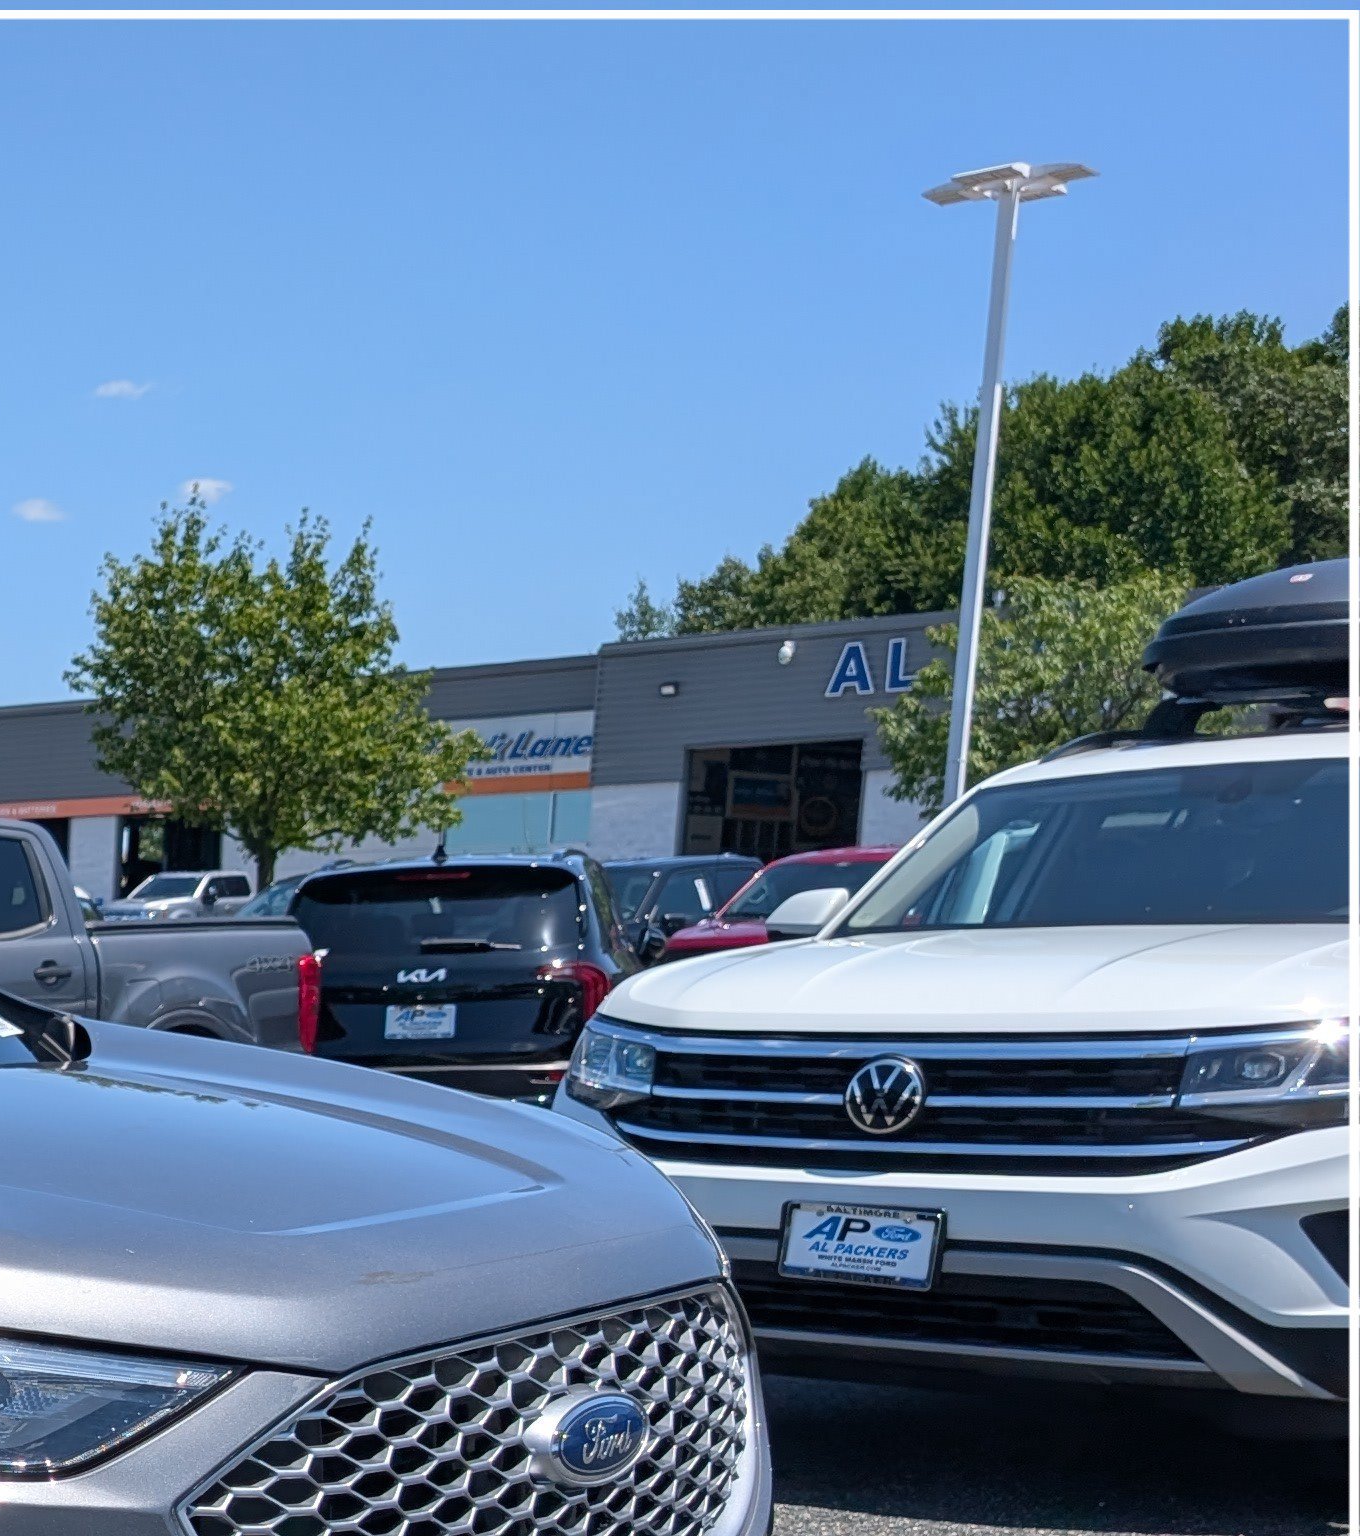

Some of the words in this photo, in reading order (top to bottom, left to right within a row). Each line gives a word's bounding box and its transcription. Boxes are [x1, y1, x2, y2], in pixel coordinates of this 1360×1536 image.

[508, 731, 593, 760] Lane
[485, 766, 511, 775] AUTO
[512, 763, 551, 774] CENTER
[826, 1205, 900, 1219] BALTIMORE
[802, 1215, 871, 1242] AP
[880, 1226, 914, 1243] Ford
[808, 1241, 829, 1253] AL
[833, 1243, 910, 1261] PACKERS
[844, 1256, 873, 1265] MARSH
[874, 1259, 898, 1268] FORD
[581, 1412, 633, 1465] Ford
